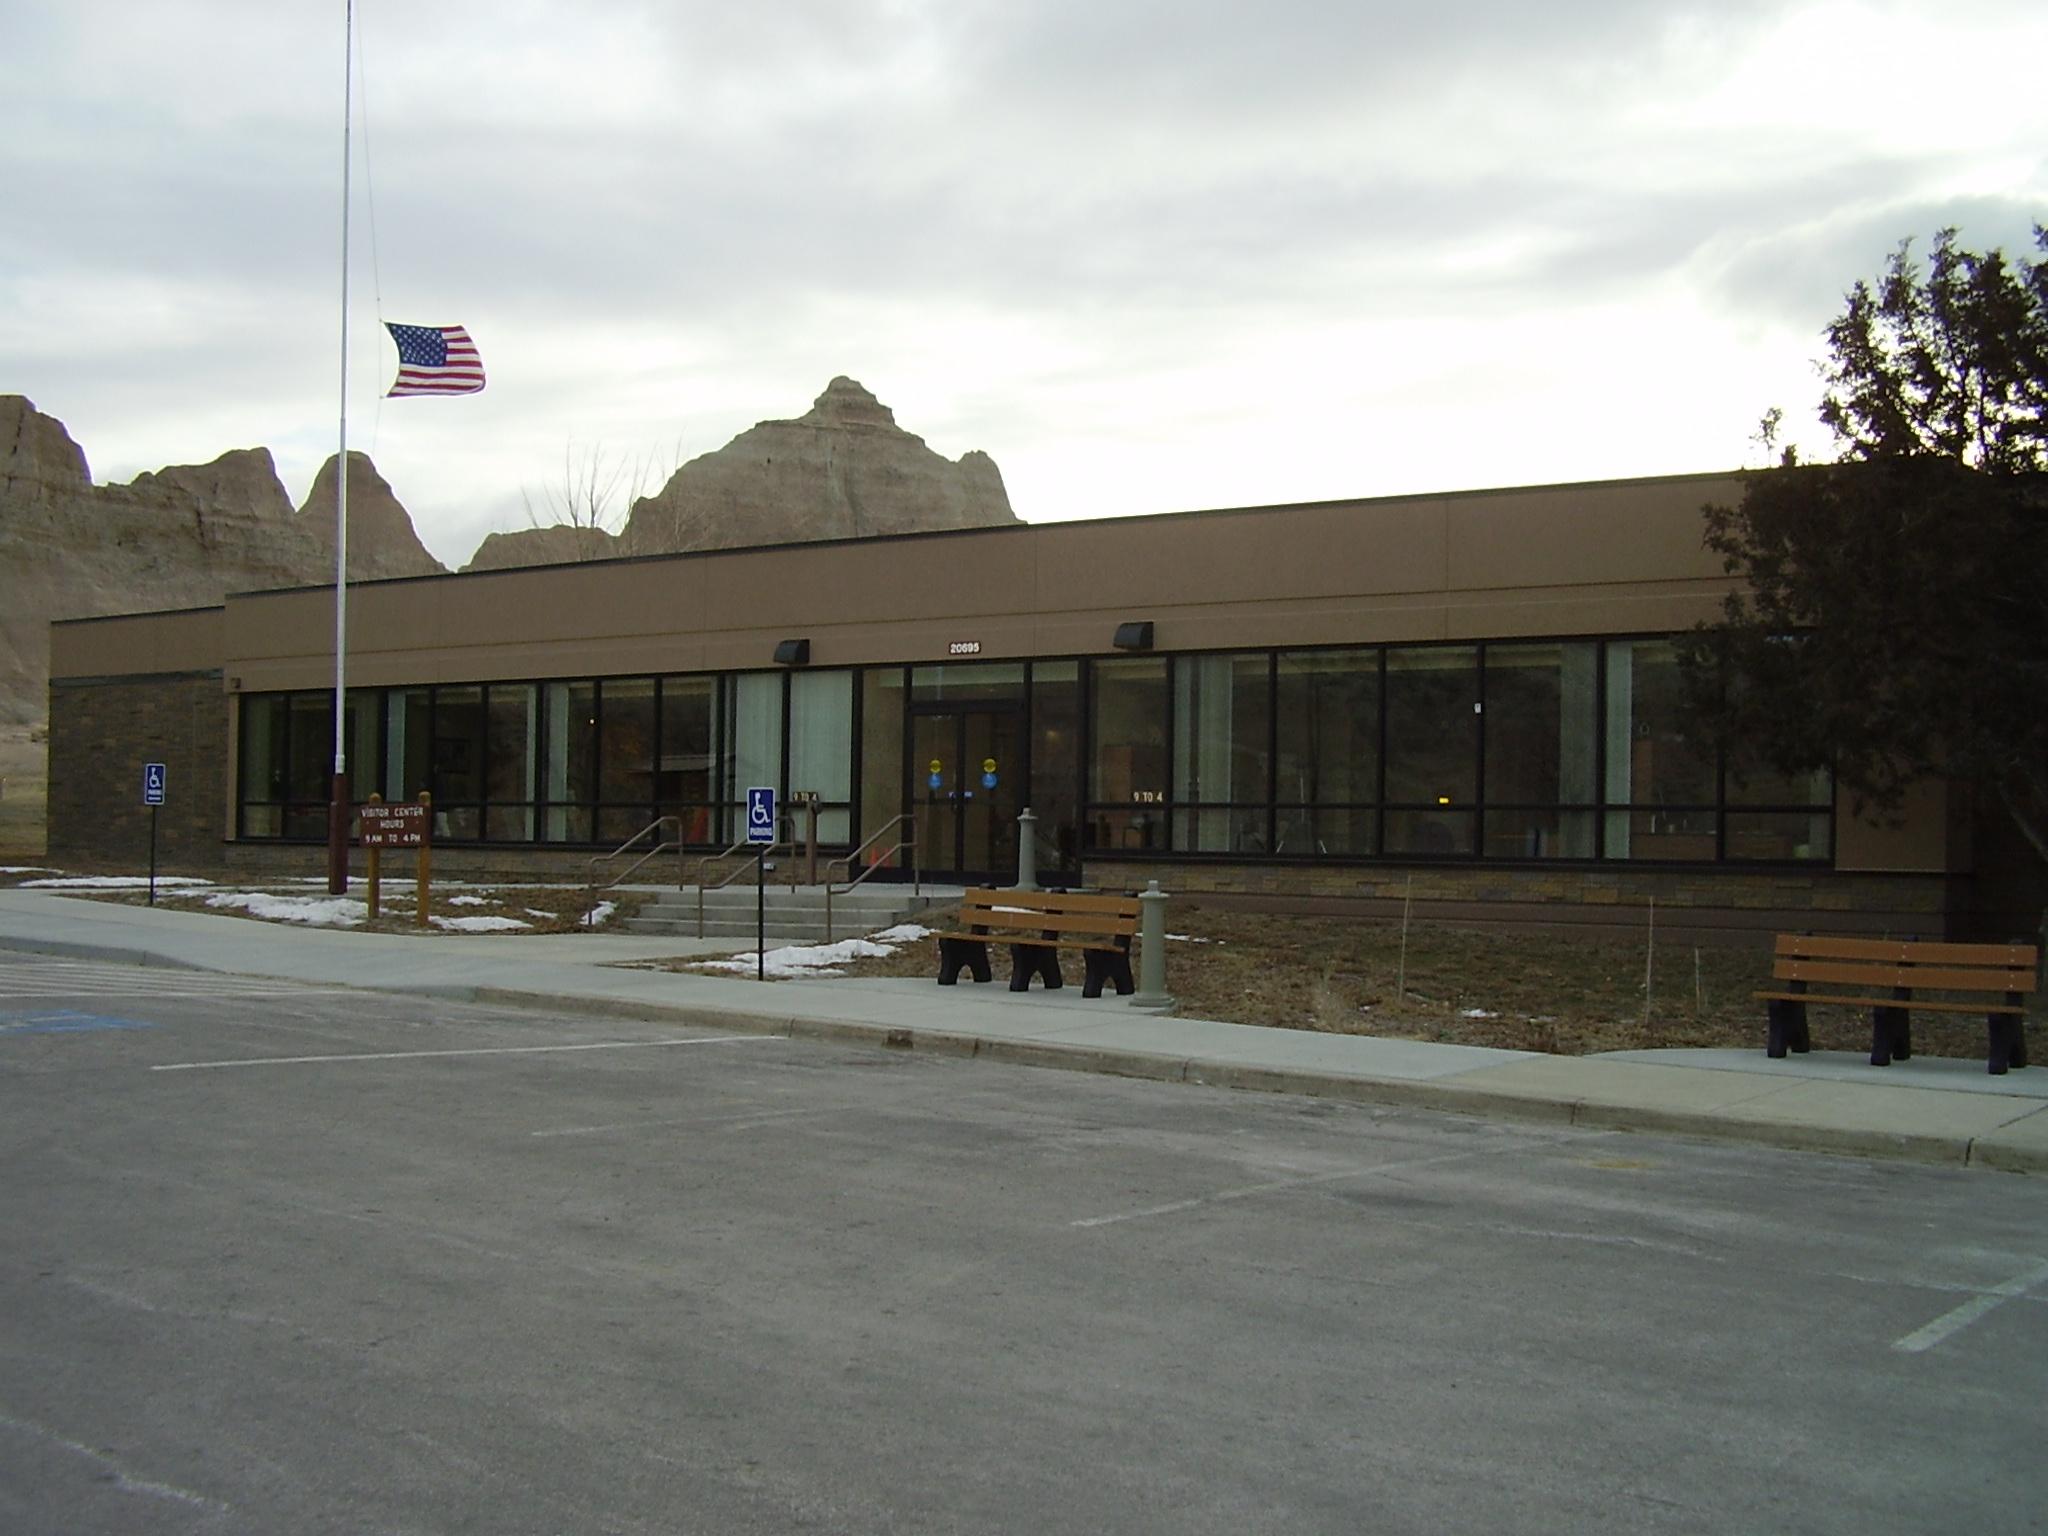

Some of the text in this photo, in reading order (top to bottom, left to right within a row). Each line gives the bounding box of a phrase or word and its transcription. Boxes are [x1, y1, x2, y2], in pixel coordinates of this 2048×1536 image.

[1133, 791, 1163, 803] 9 TO 4
[361, 806, 424, 817] VISITOR CENTER
[380, 819, 405, 829] HOURS
[388, 834, 398, 843] TO
